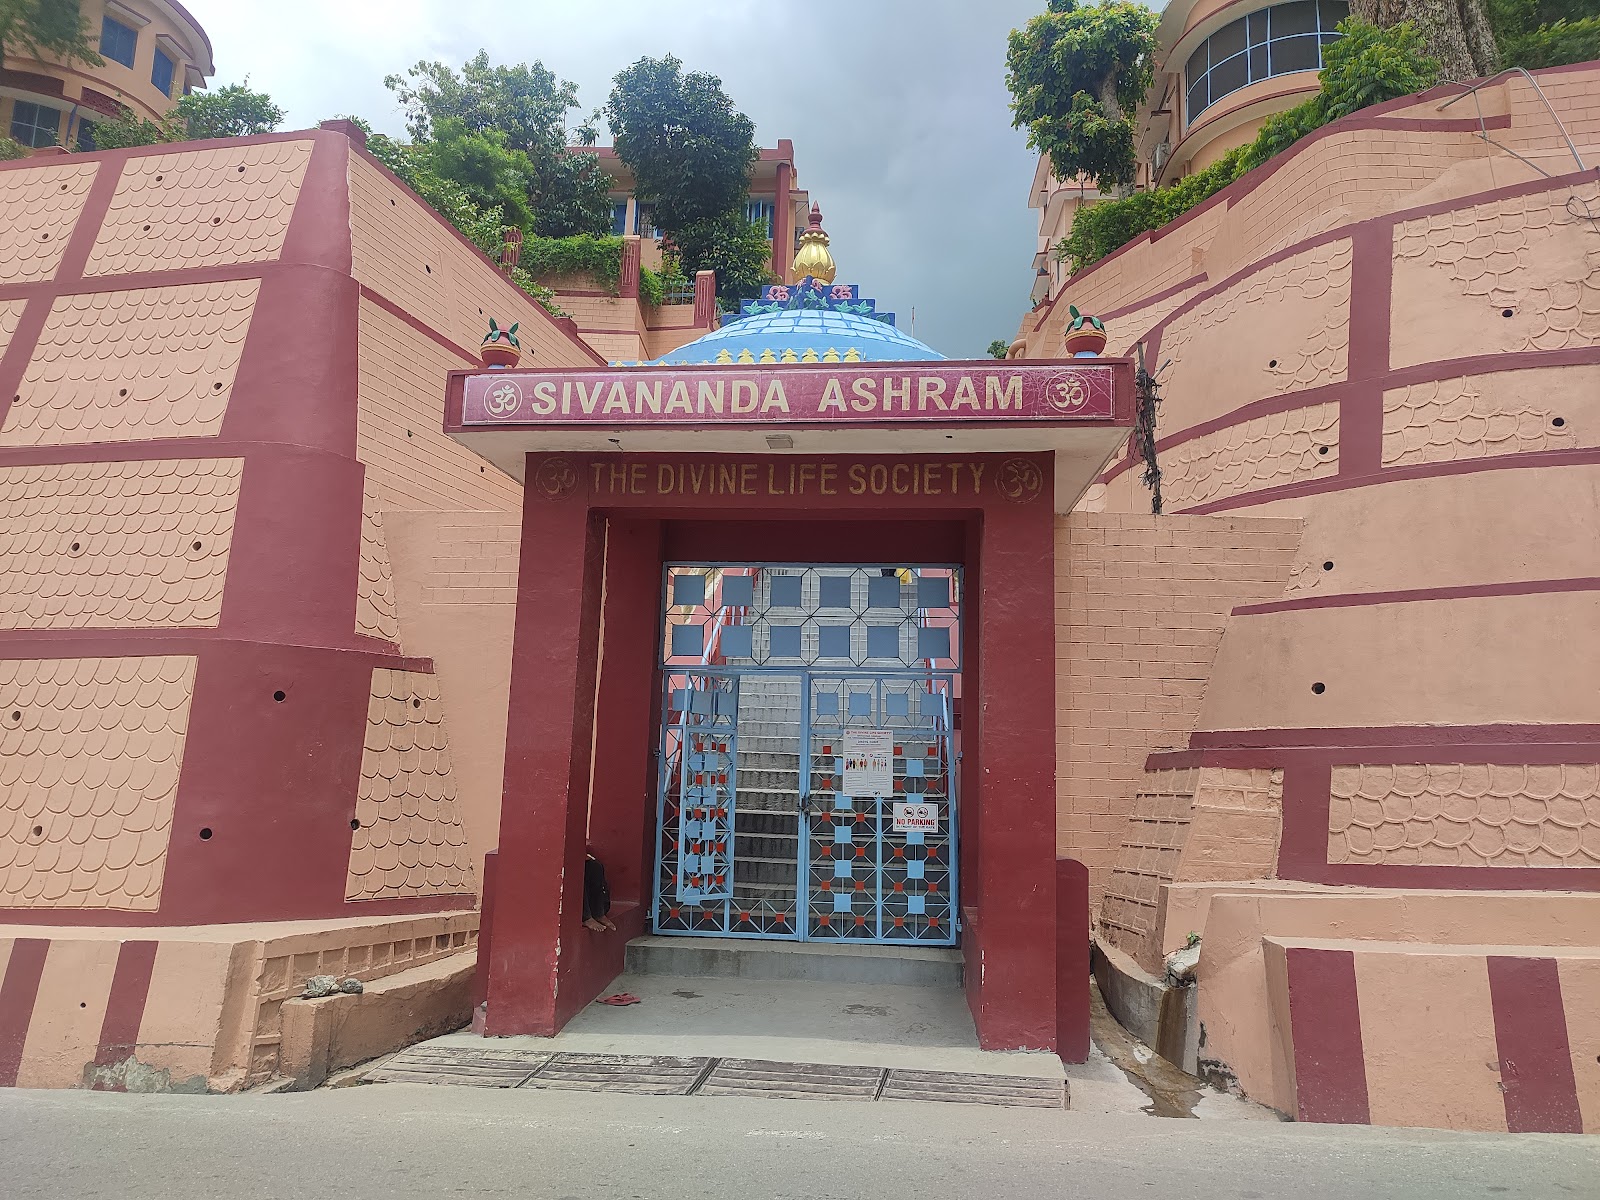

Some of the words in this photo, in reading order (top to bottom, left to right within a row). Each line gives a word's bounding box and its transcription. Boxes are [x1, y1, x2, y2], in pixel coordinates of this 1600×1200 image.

[531, 379, 791, 415] SIVANANDA
[816, 375, 1024, 413] ASHRAM
[590, 463, 648, 495] THE
[657, 463, 758, 495] DIVINE
[768, 463, 838, 495] LIFE
[847, 462, 986, 495] SOCIETY
